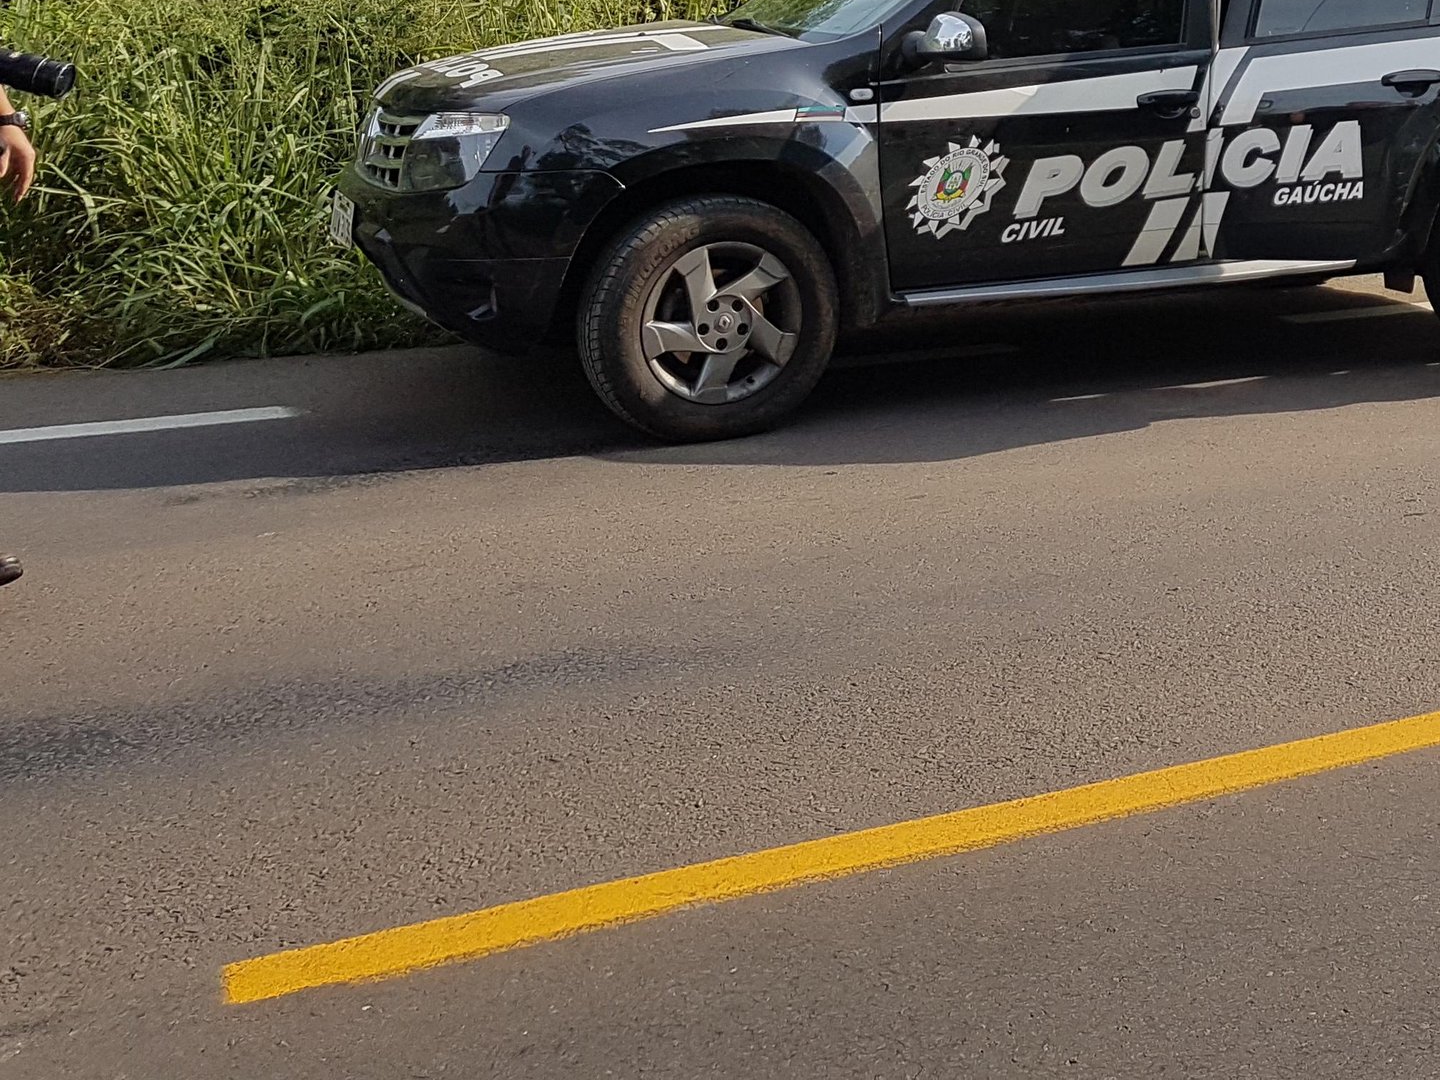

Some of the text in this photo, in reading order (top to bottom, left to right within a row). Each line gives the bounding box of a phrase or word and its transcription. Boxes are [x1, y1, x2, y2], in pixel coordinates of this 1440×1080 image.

[920, 165, 940, 194] ESTADO
[940, 156, 951, 166] DO
[952, 150, 965, 159] RIO
[1013, 120, 1364, 219] POLÍCIA
[1273, 181, 1364, 207] GAÚCHA
[1001, 217, 1065, 244] CIVIL
